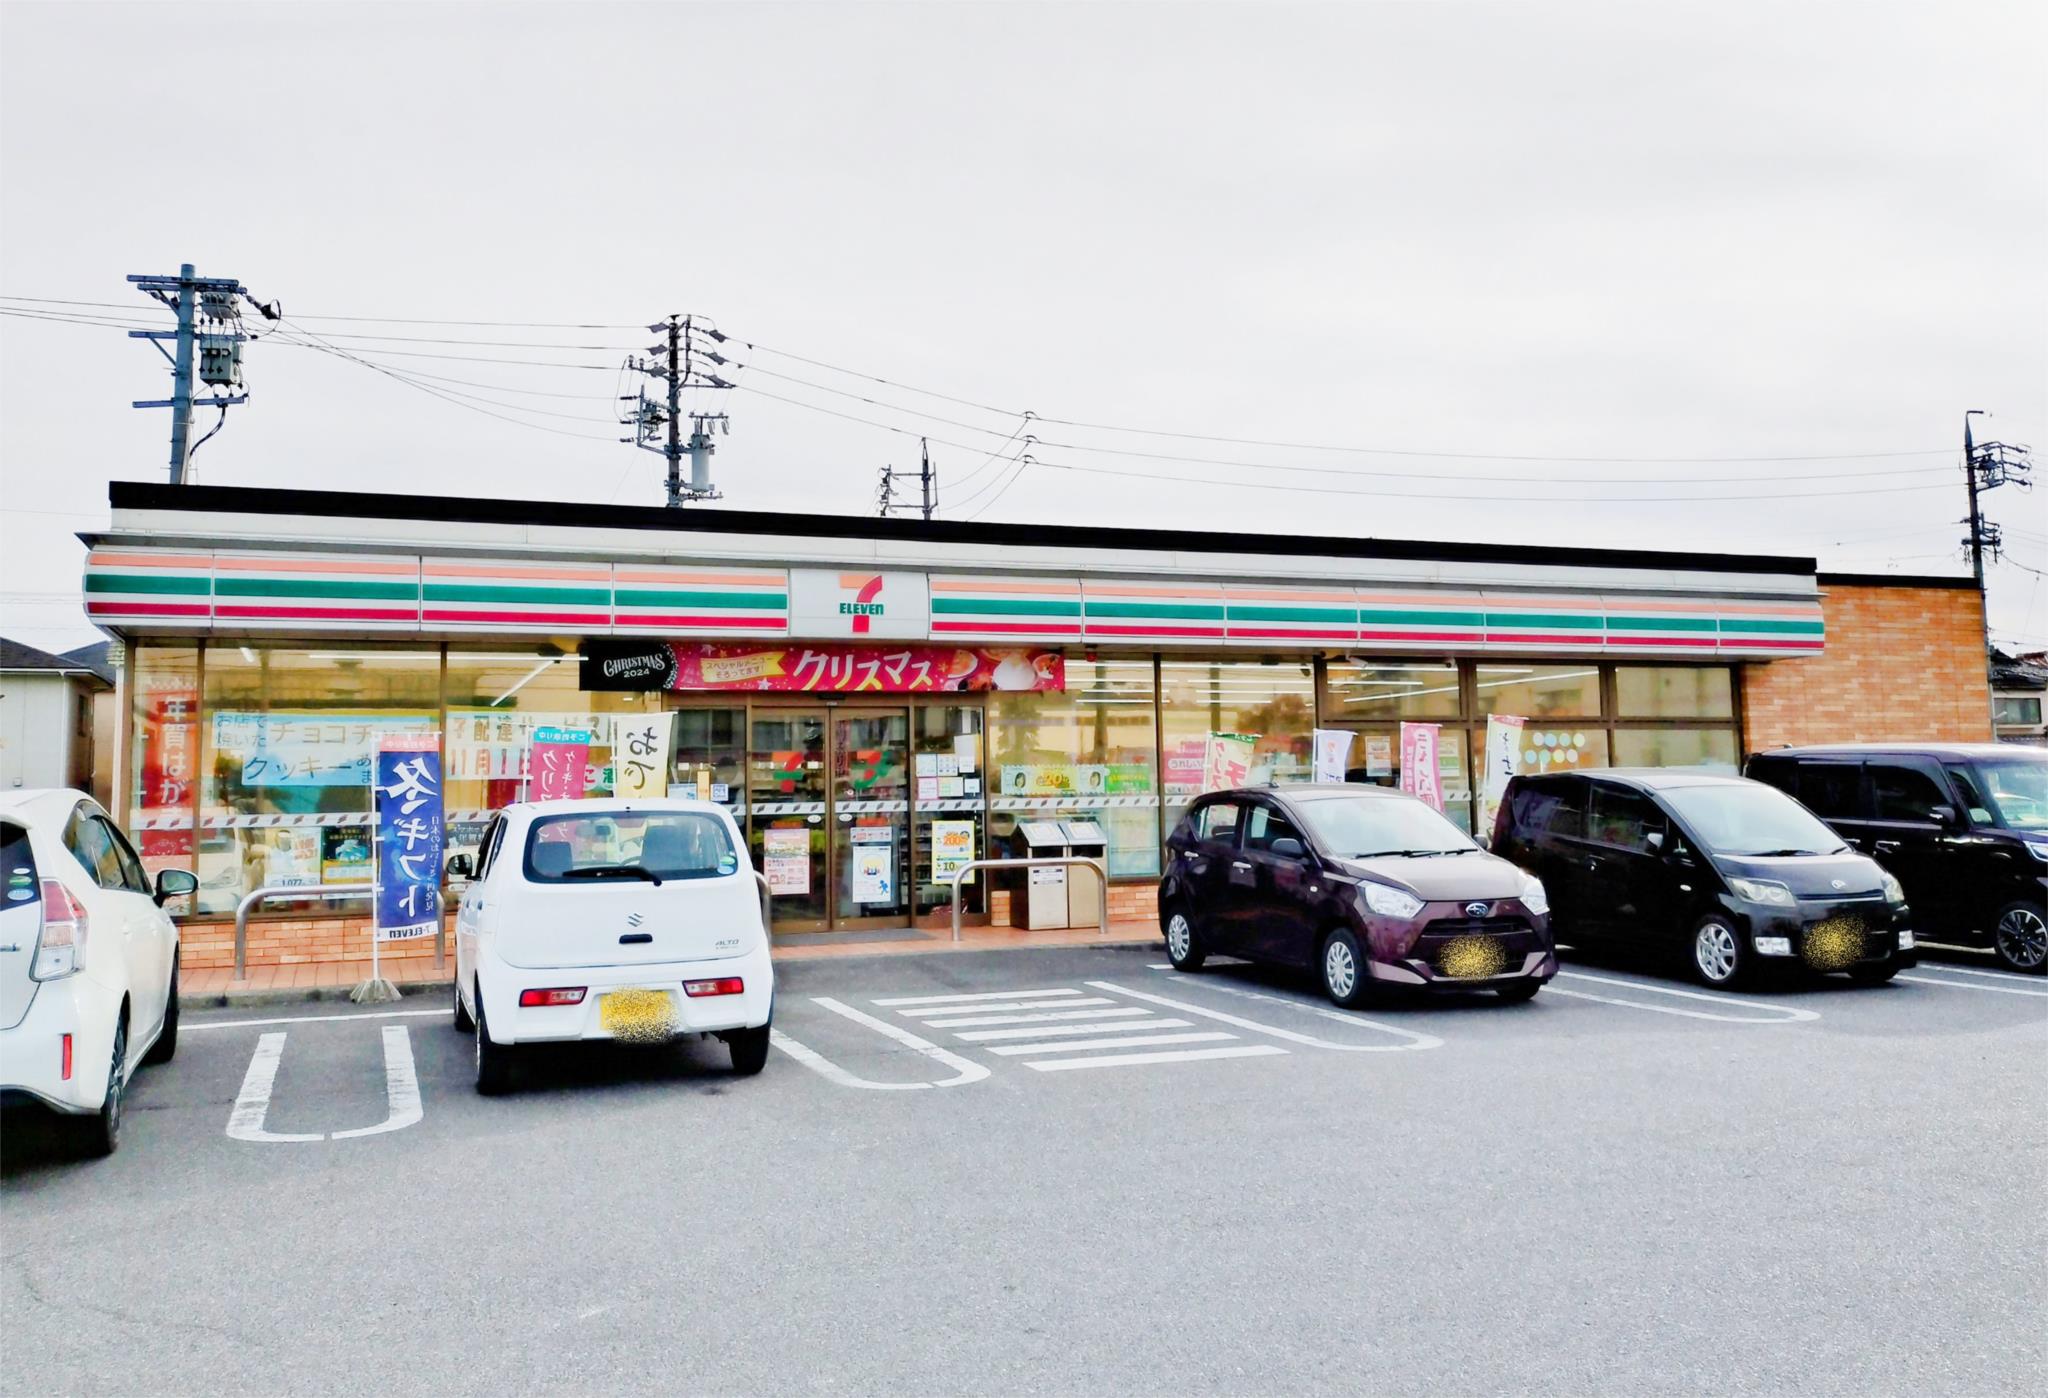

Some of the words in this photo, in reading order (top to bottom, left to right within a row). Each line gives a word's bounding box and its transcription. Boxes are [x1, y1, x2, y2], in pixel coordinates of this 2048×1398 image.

[603, 653, 666, 677] CHRISTMAS
[623, 668, 650, 678] 2024
[792, 650, 933, 692] クリスマス
[244, 755, 353, 781] クッキー
